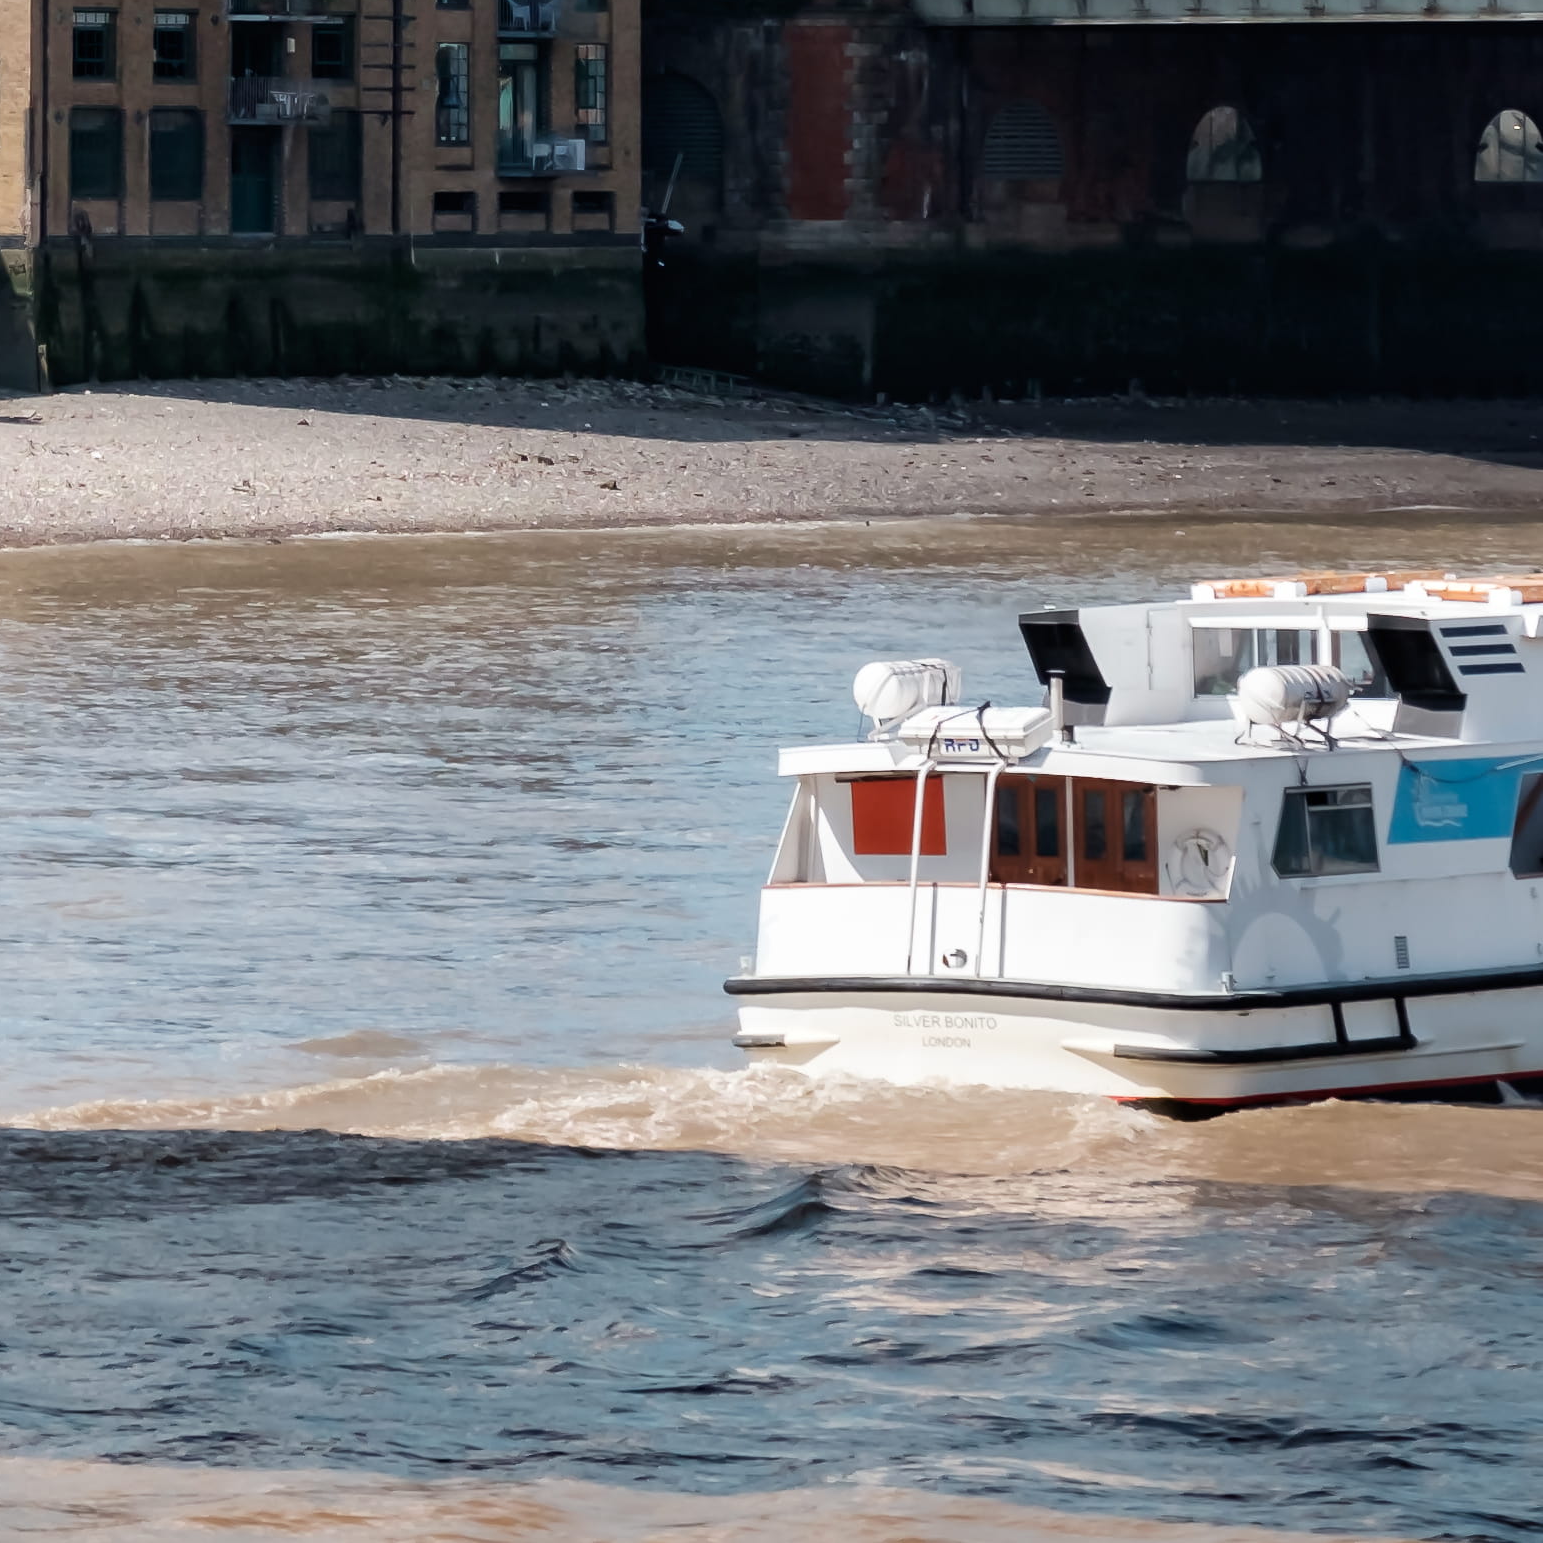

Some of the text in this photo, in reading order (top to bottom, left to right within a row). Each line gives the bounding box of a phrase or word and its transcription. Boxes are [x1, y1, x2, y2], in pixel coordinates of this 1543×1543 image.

[894, 1015, 998, 1030] SILVER BONITO
[922, 1036, 972, 1048] LONDON
